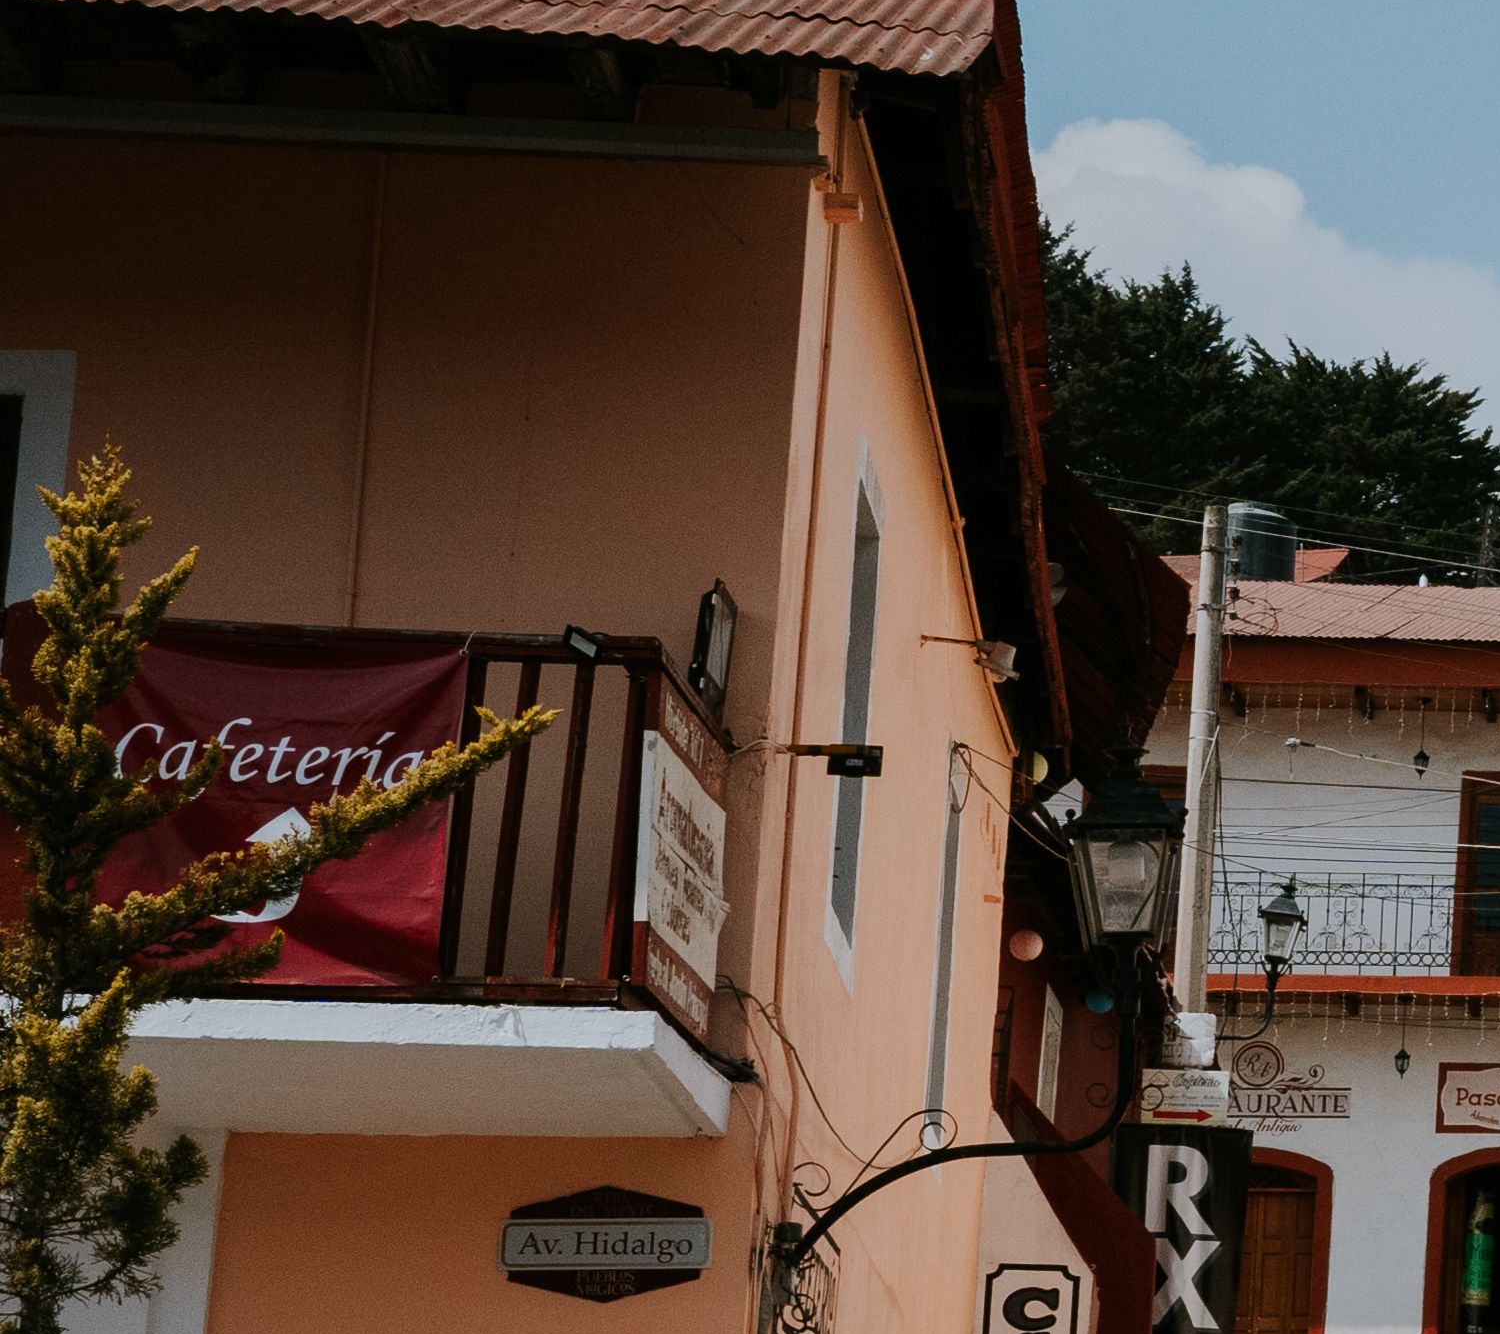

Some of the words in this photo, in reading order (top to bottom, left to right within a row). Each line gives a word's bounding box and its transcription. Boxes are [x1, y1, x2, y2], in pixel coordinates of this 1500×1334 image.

[1227, 1094, 1349, 1115] AURANTE
[517, 1232, 563, 1256] Av.
[573, 1231, 693, 1264] Hidalgo
